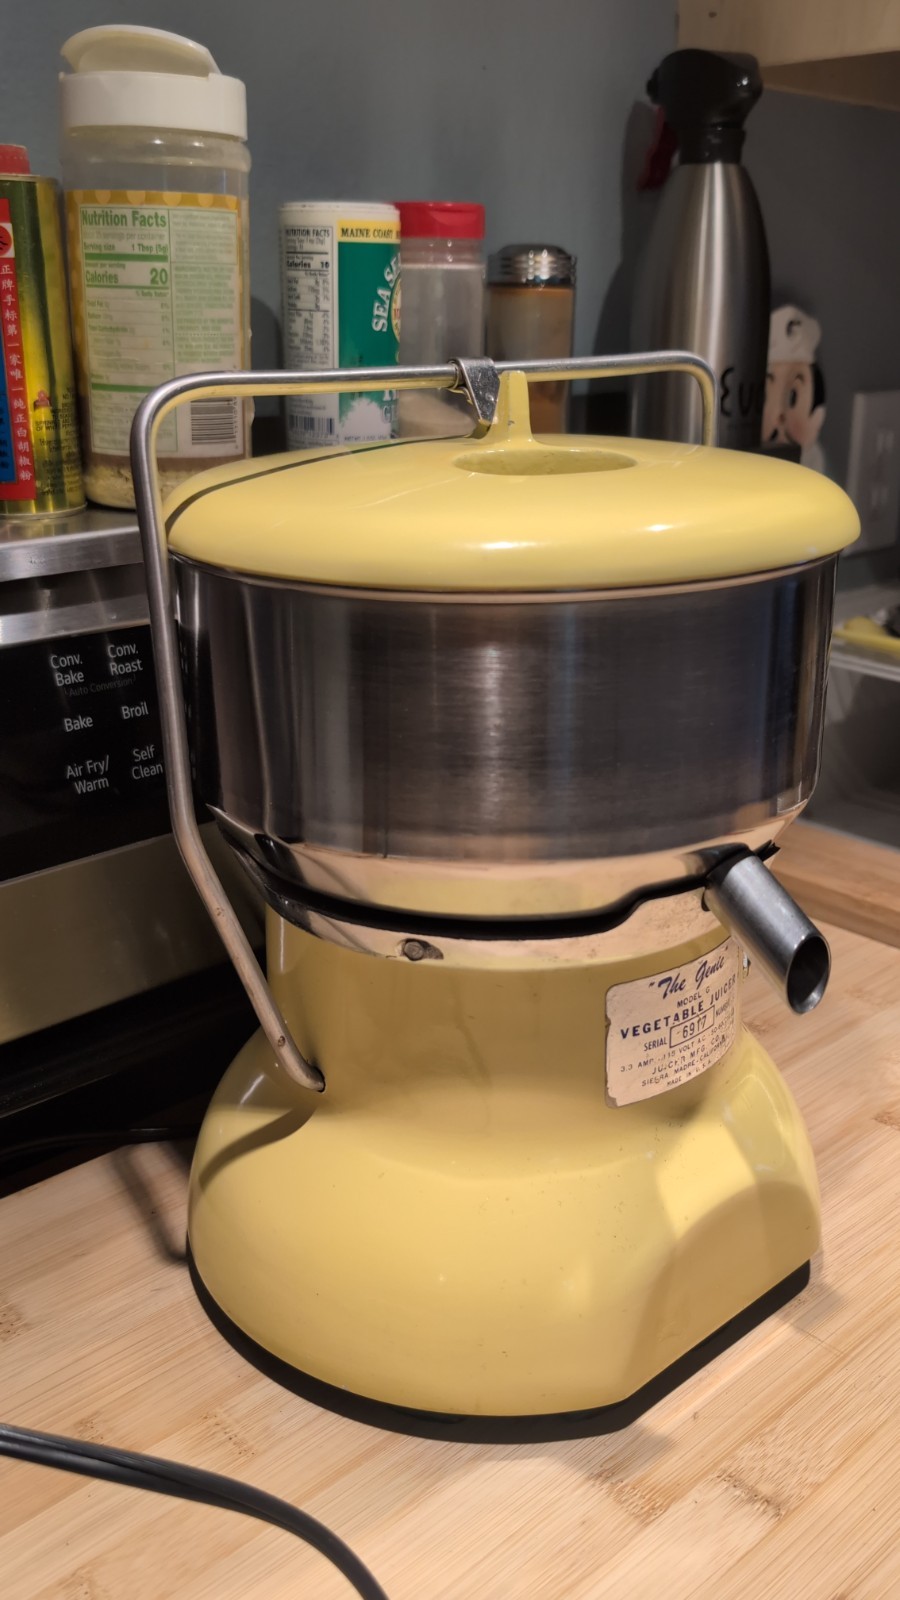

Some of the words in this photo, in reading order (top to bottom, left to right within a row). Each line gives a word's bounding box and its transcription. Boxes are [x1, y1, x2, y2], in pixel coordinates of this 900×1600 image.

[82, 210, 127, 227] Nutrition
[131, 210, 167, 228] Facts
[312, 229, 330, 238] FACTS
[341, 228, 371, 238] MAINE
[85, 270, 119, 284] Calories
[150, 267, 168, 285] 20
[371, 287, 392, 332] SEA
[107, 642, 139, 659] Conv.
[50, 653, 83, 670] Conv.
[109, 658, 143, 676] Roast
[55, 670, 85, 687] Bake
[121, 701, 149, 720] Broil
[64, 715, 94, 733] Bake
[132, 744, 156, 762] Self
[66, 763, 83, 779] Air
[86, 755, 110, 775] Fry/
[131, 762, 164, 781] Clean
[74, 776, 110, 795] Warm
[620, 1000, 704, 1040] VEGETABLE
[710, 973, 736, 1005] JUICER
[676, 992, 702, 1008] MODEL
[643, 1036, 668, 1052] SERIAL
[678, 1041, 695, 1054] VOLT
[666, 1075, 683, 1088] MADE
